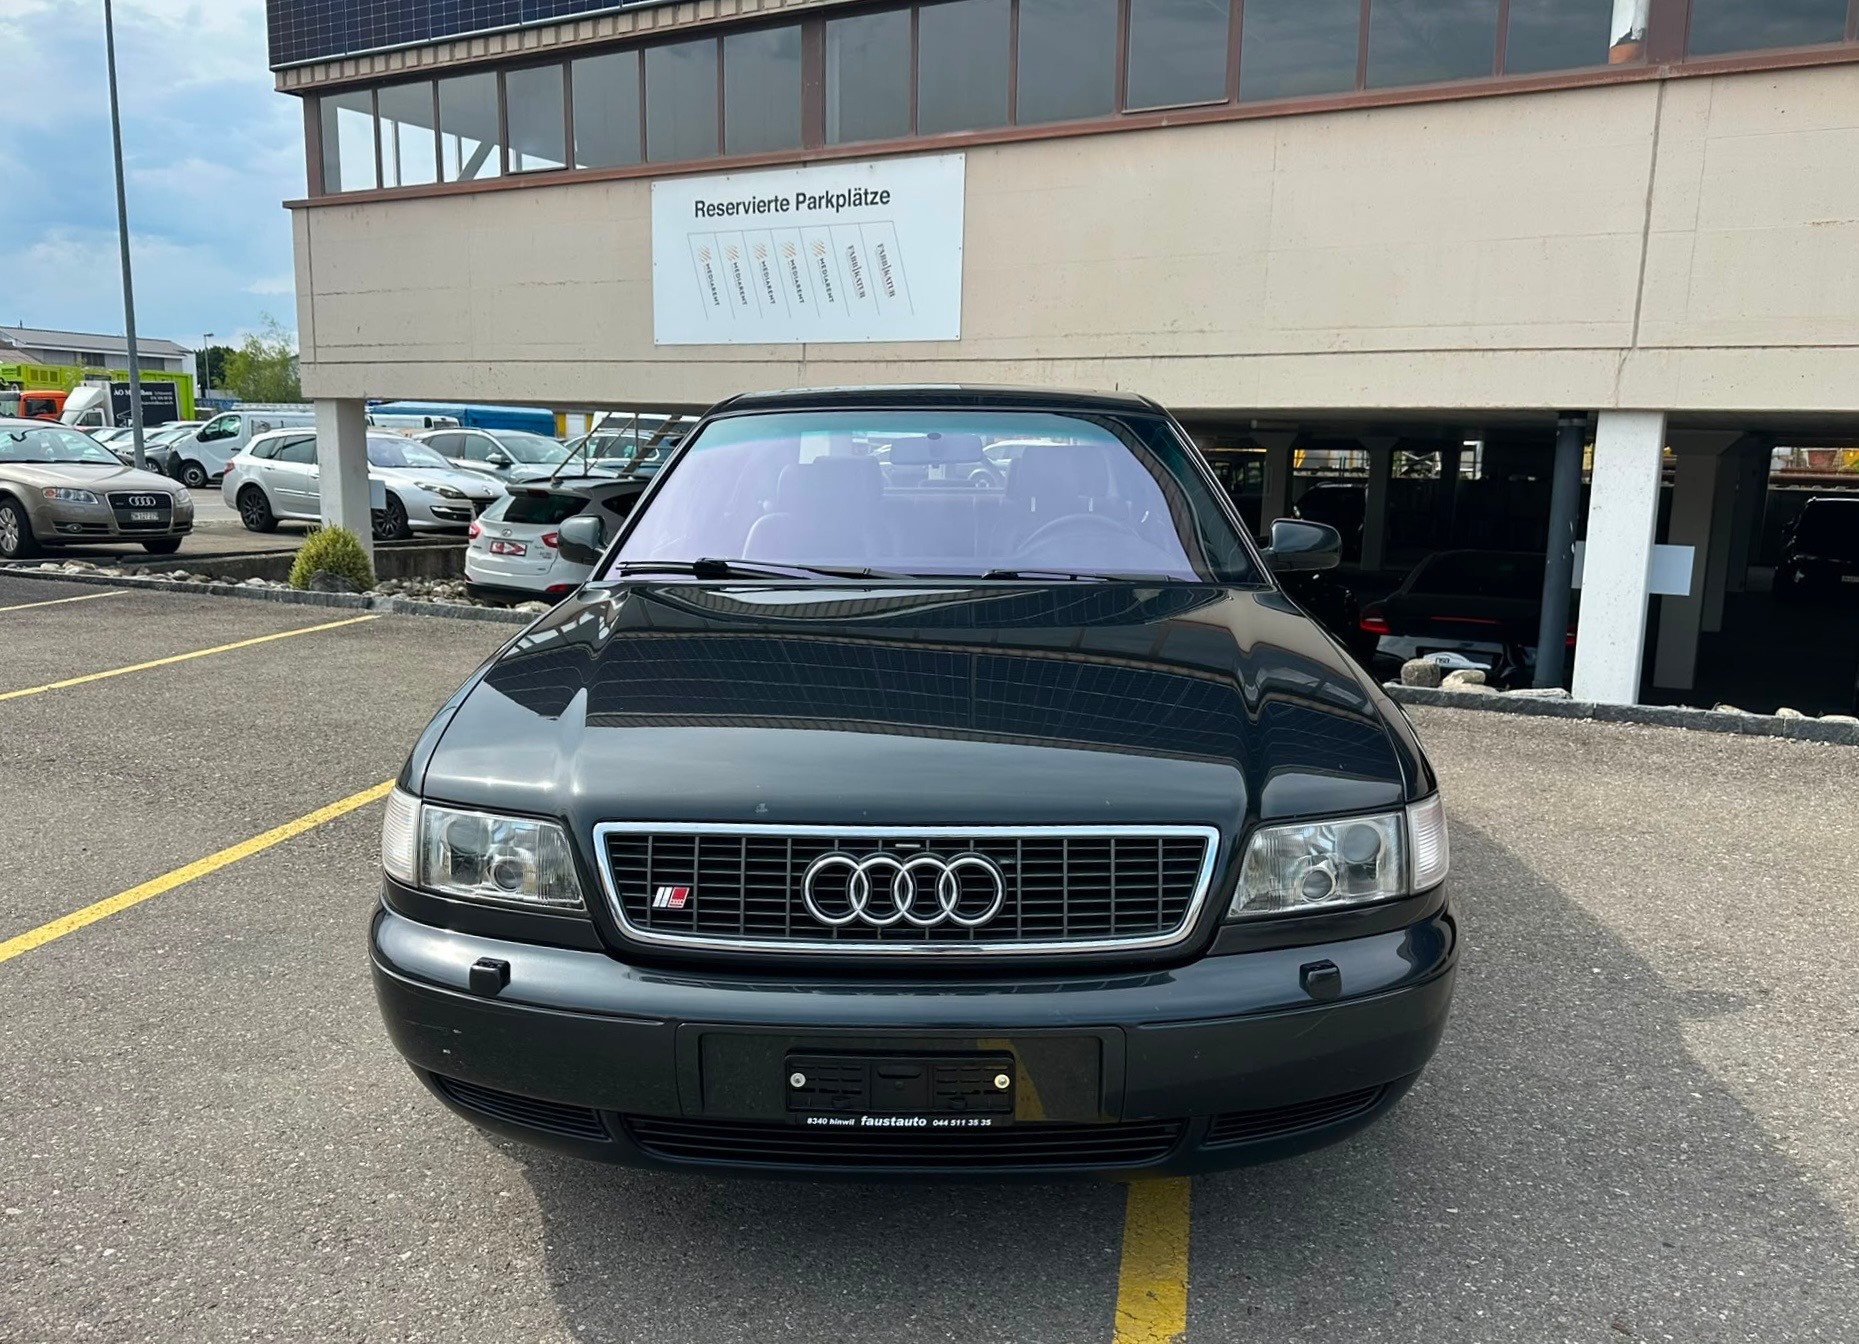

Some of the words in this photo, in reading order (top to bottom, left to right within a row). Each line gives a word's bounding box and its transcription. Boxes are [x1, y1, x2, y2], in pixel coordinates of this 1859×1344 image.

[694, 195, 790, 218] Reservierte
[795, 187, 891, 213] Parkplätze
[705, 263, 720, 306] MEDIARENT
[733, 262, 748, 305] MEDIARENT
[761, 261, 776, 304] MEDIARENT
[789, 259, 804, 303] MEDIARENT
[820, 257, 834, 302] MEDIARENT
[806, 1117, 828, 1125] 8340
[829, 1117, 855, 1126] hinwil
[860, 1115, 927, 1127] faustauto
[932, 1118, 949, 1127] 044
[949, 1118, 966, 1127] 511
[967, 1118, 979, 1127] 35
[980, 1118, 992, 1127] 35
